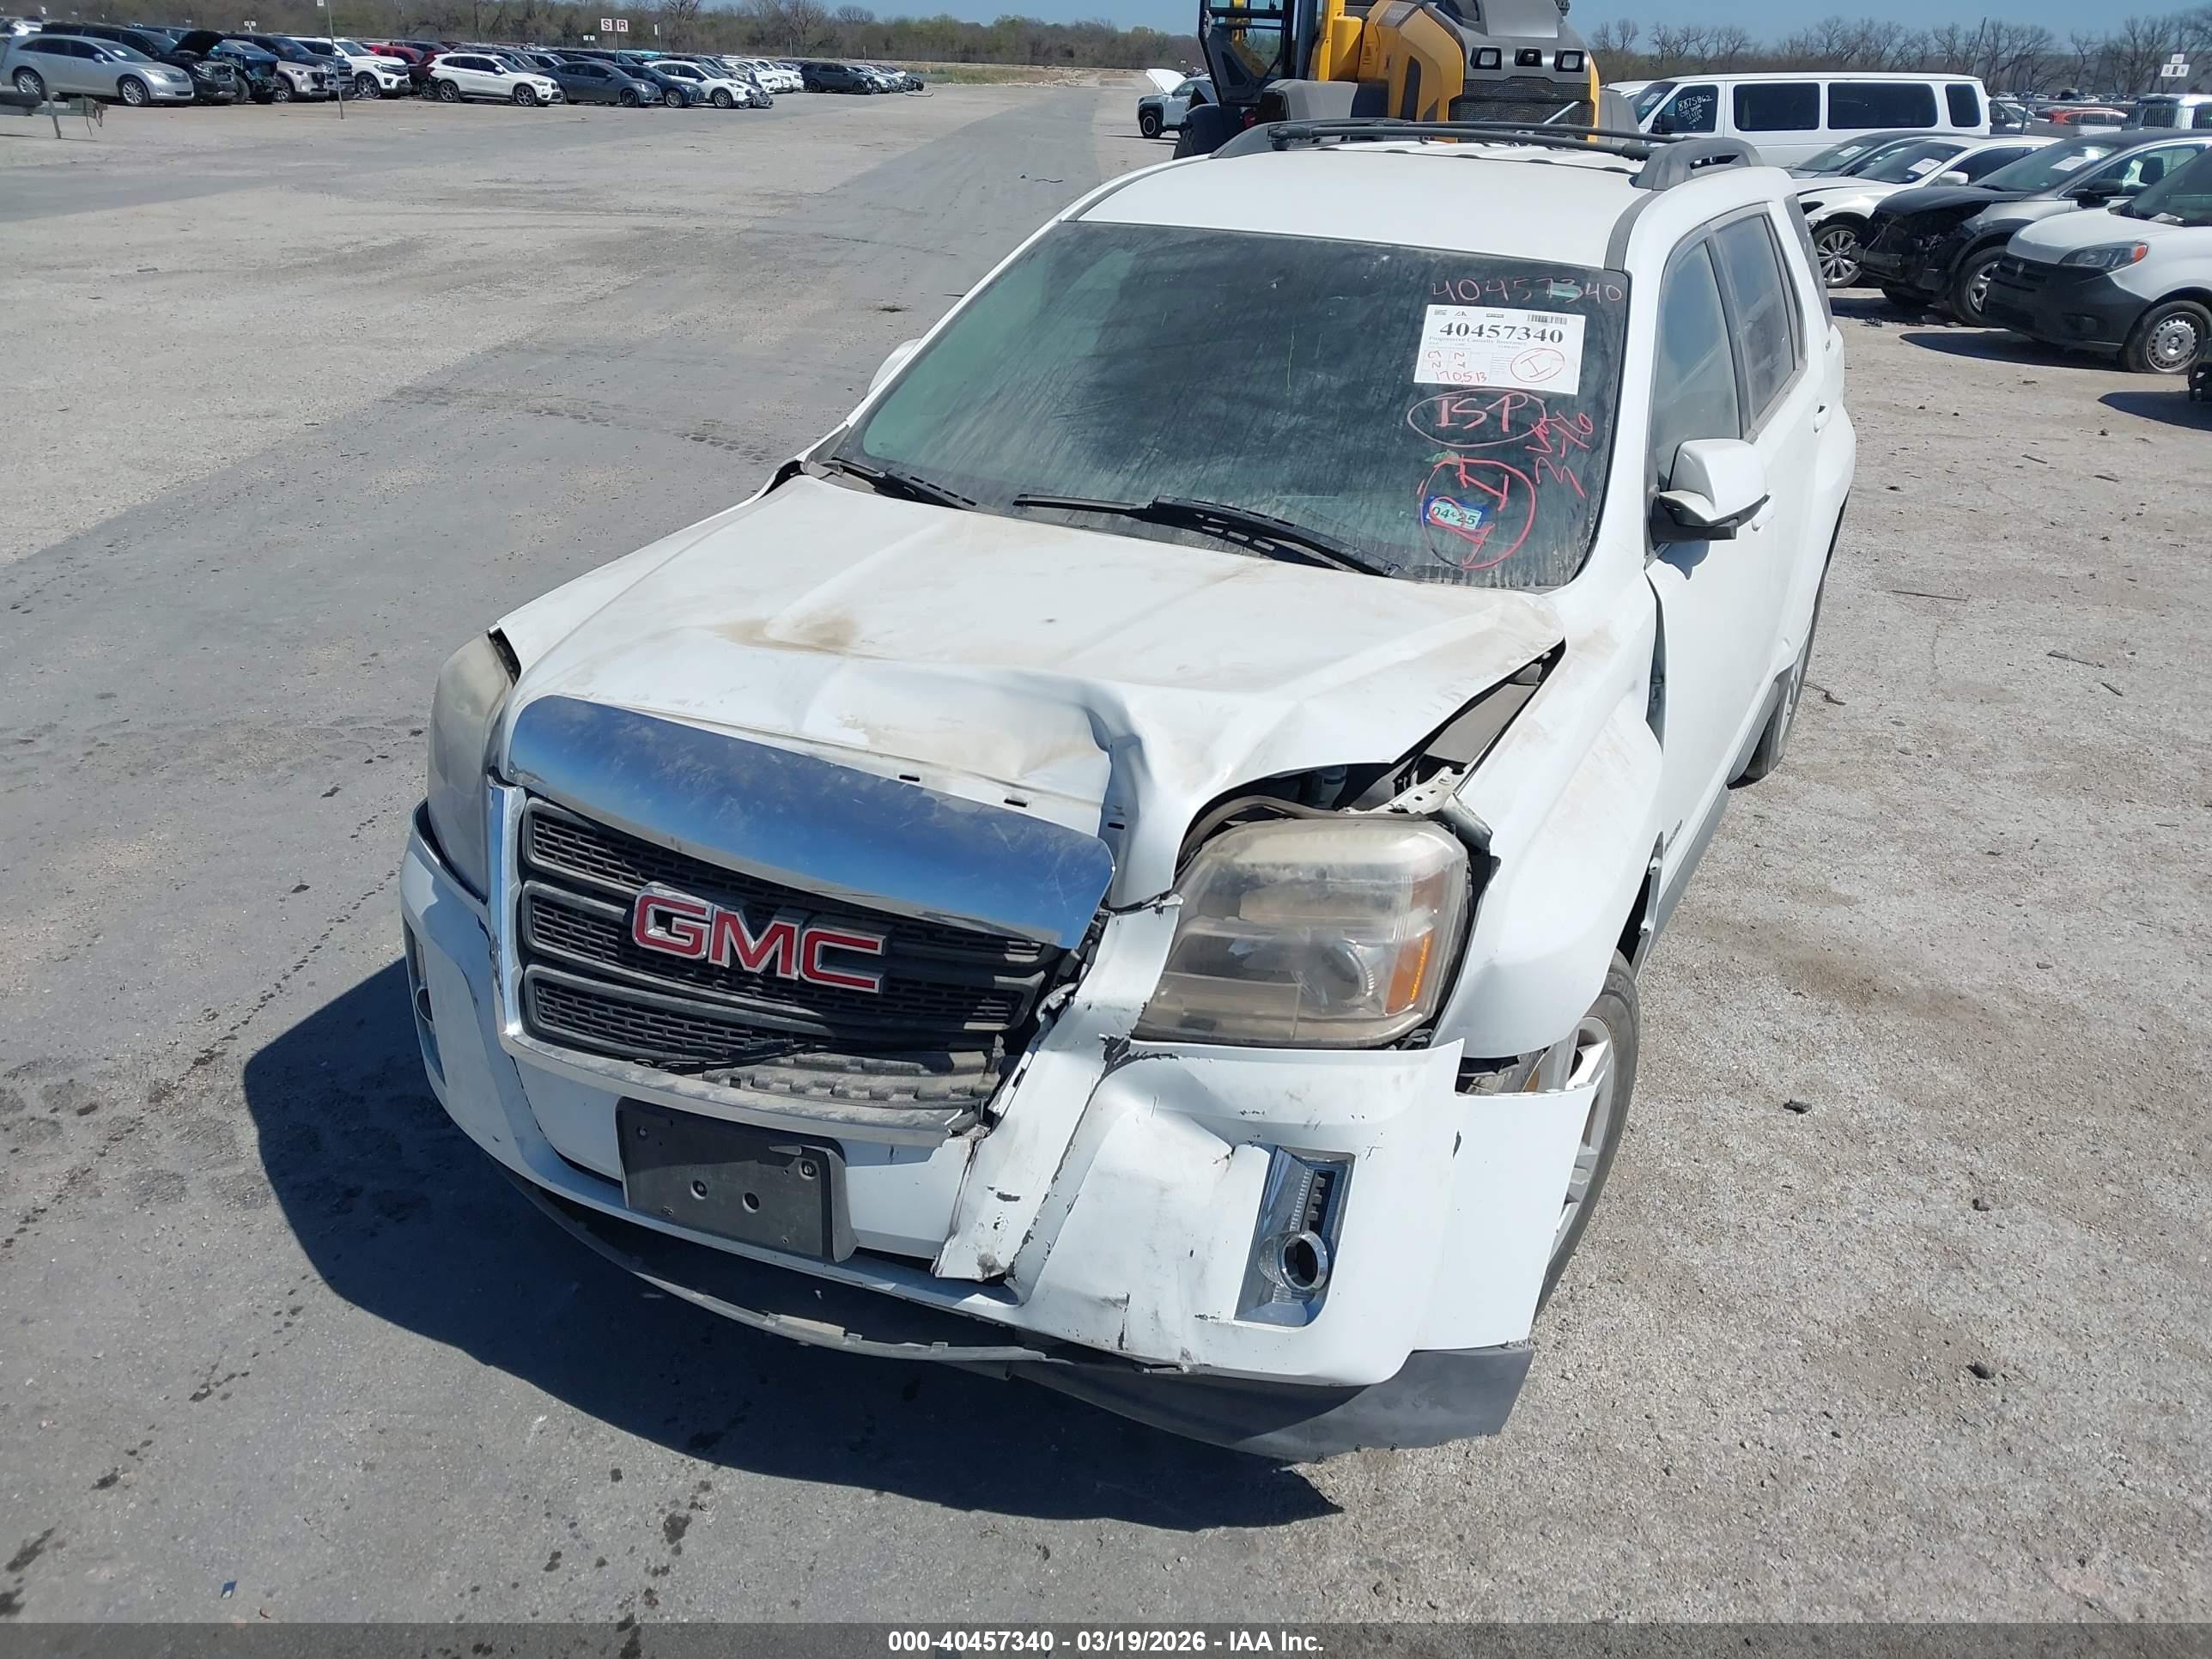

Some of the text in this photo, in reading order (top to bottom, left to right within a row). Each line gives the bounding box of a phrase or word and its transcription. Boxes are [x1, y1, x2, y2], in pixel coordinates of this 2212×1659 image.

[603, 20, 626, 30] S R
[1439, 322, 1564, 344] 40457340
[632, 881, 887, 994] GMC
